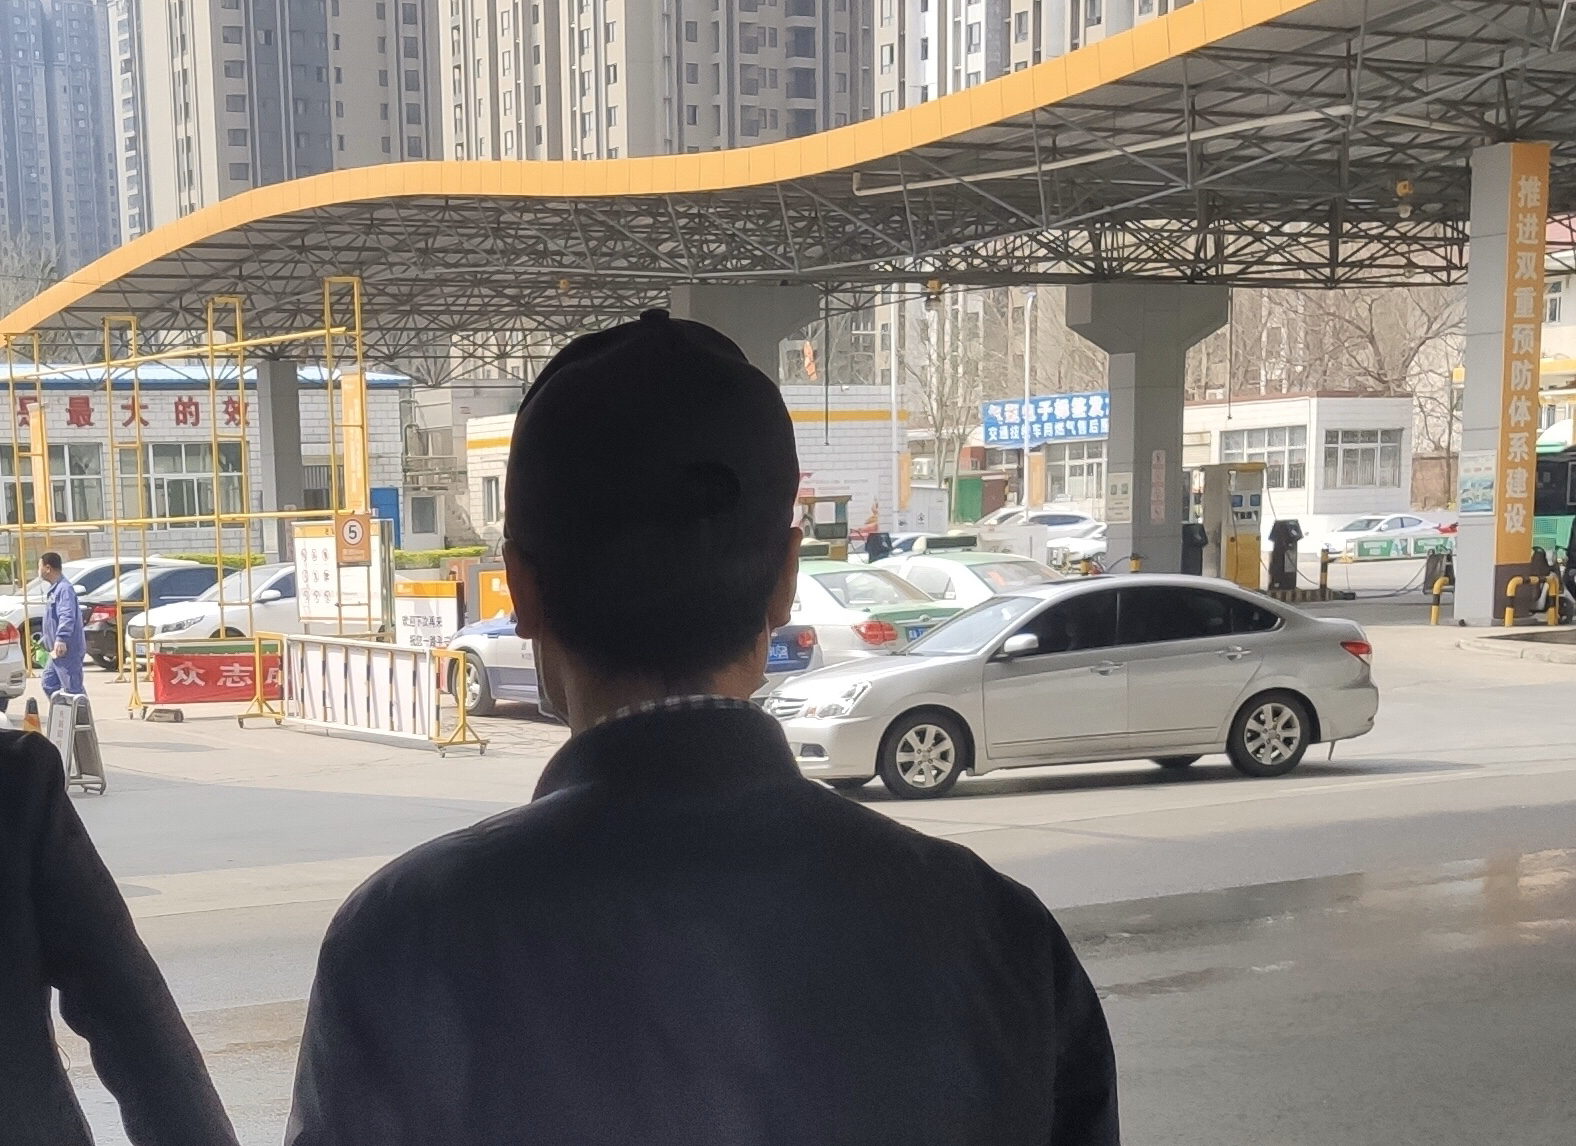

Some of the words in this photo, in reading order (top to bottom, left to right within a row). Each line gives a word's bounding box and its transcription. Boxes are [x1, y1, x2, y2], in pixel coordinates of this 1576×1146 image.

[1504, 175, 1541, 533] 推进双重预防体系建设
[348, 524, 358, 540] 5
